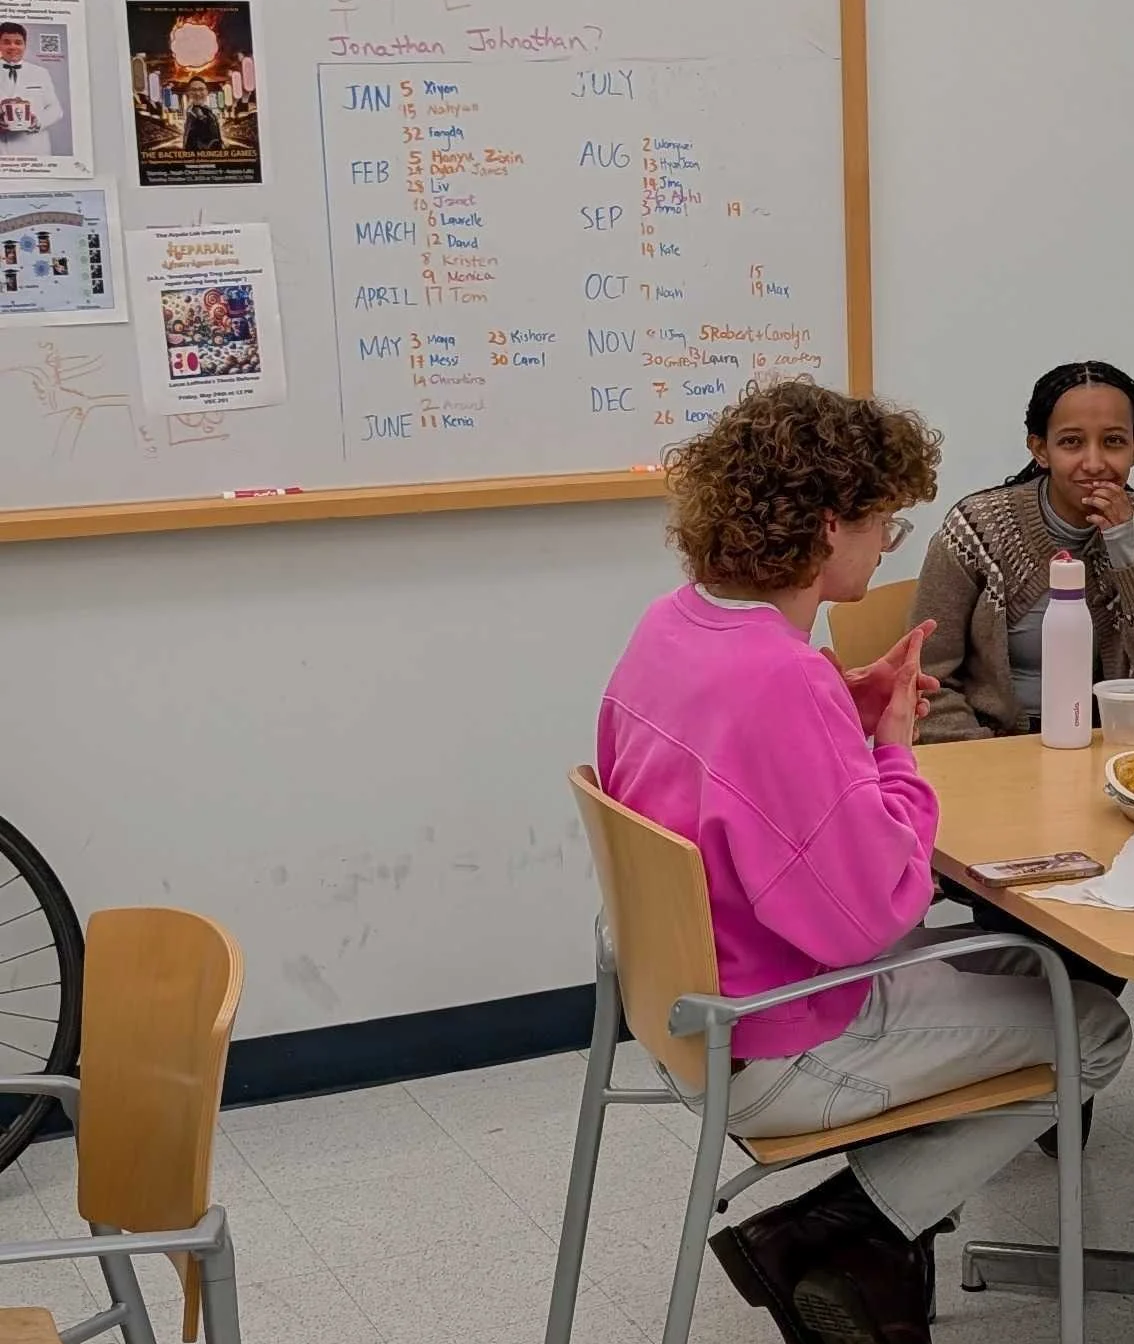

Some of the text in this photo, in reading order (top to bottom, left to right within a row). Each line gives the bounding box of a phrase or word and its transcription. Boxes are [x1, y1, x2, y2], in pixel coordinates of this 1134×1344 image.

[328, 34, 446, 56] Jonathan
[342, 84, 392, 112] JAN
[400, 80, 413, 97] 5
[571, 69, 634, 99] JULY
[401, 126, 424, 144] 32
[579, 140, 632, 168] AUG
[642, 137, 651, 152] 2
[643, 158, 658, 173] 13
[351, 160, 390, 185] FEB
[409, 150, 422, 165] 5
[430, 177, 450, 194] Liv
[356, 220, 416, 245] MARCH
[427, 211, 437, 227] 6
[580, 205, 624, 231] SEP
[727, 202, 742, 217] 19
[427, 233, 442, 247] 12
[659, 243, 681, 257] Kate
[355, 286, 488, 310] APRIL 17 Tom
[585, 273, 629, 300] OCT
[640, 284, 650, 300] 7
[766, 282, 790, 299] Max
[359, 336, 402, 361] MAY
[410, 333, 421, 349] 3
[488, 331, 507, 345] 23
[587, 329, 636, 357] NOV
[410, 355, 425, 369] 17
[490, 352, 508, 366] 30
[512, 351, 546, 366] Carol
[641, 352, 663, 367] 30
[590, 386, 636, 412] DEC
[653, 382, 669, 399] 7
[361, 413, 414, 441] JUNE
[653, 410, 675, 425] 26
